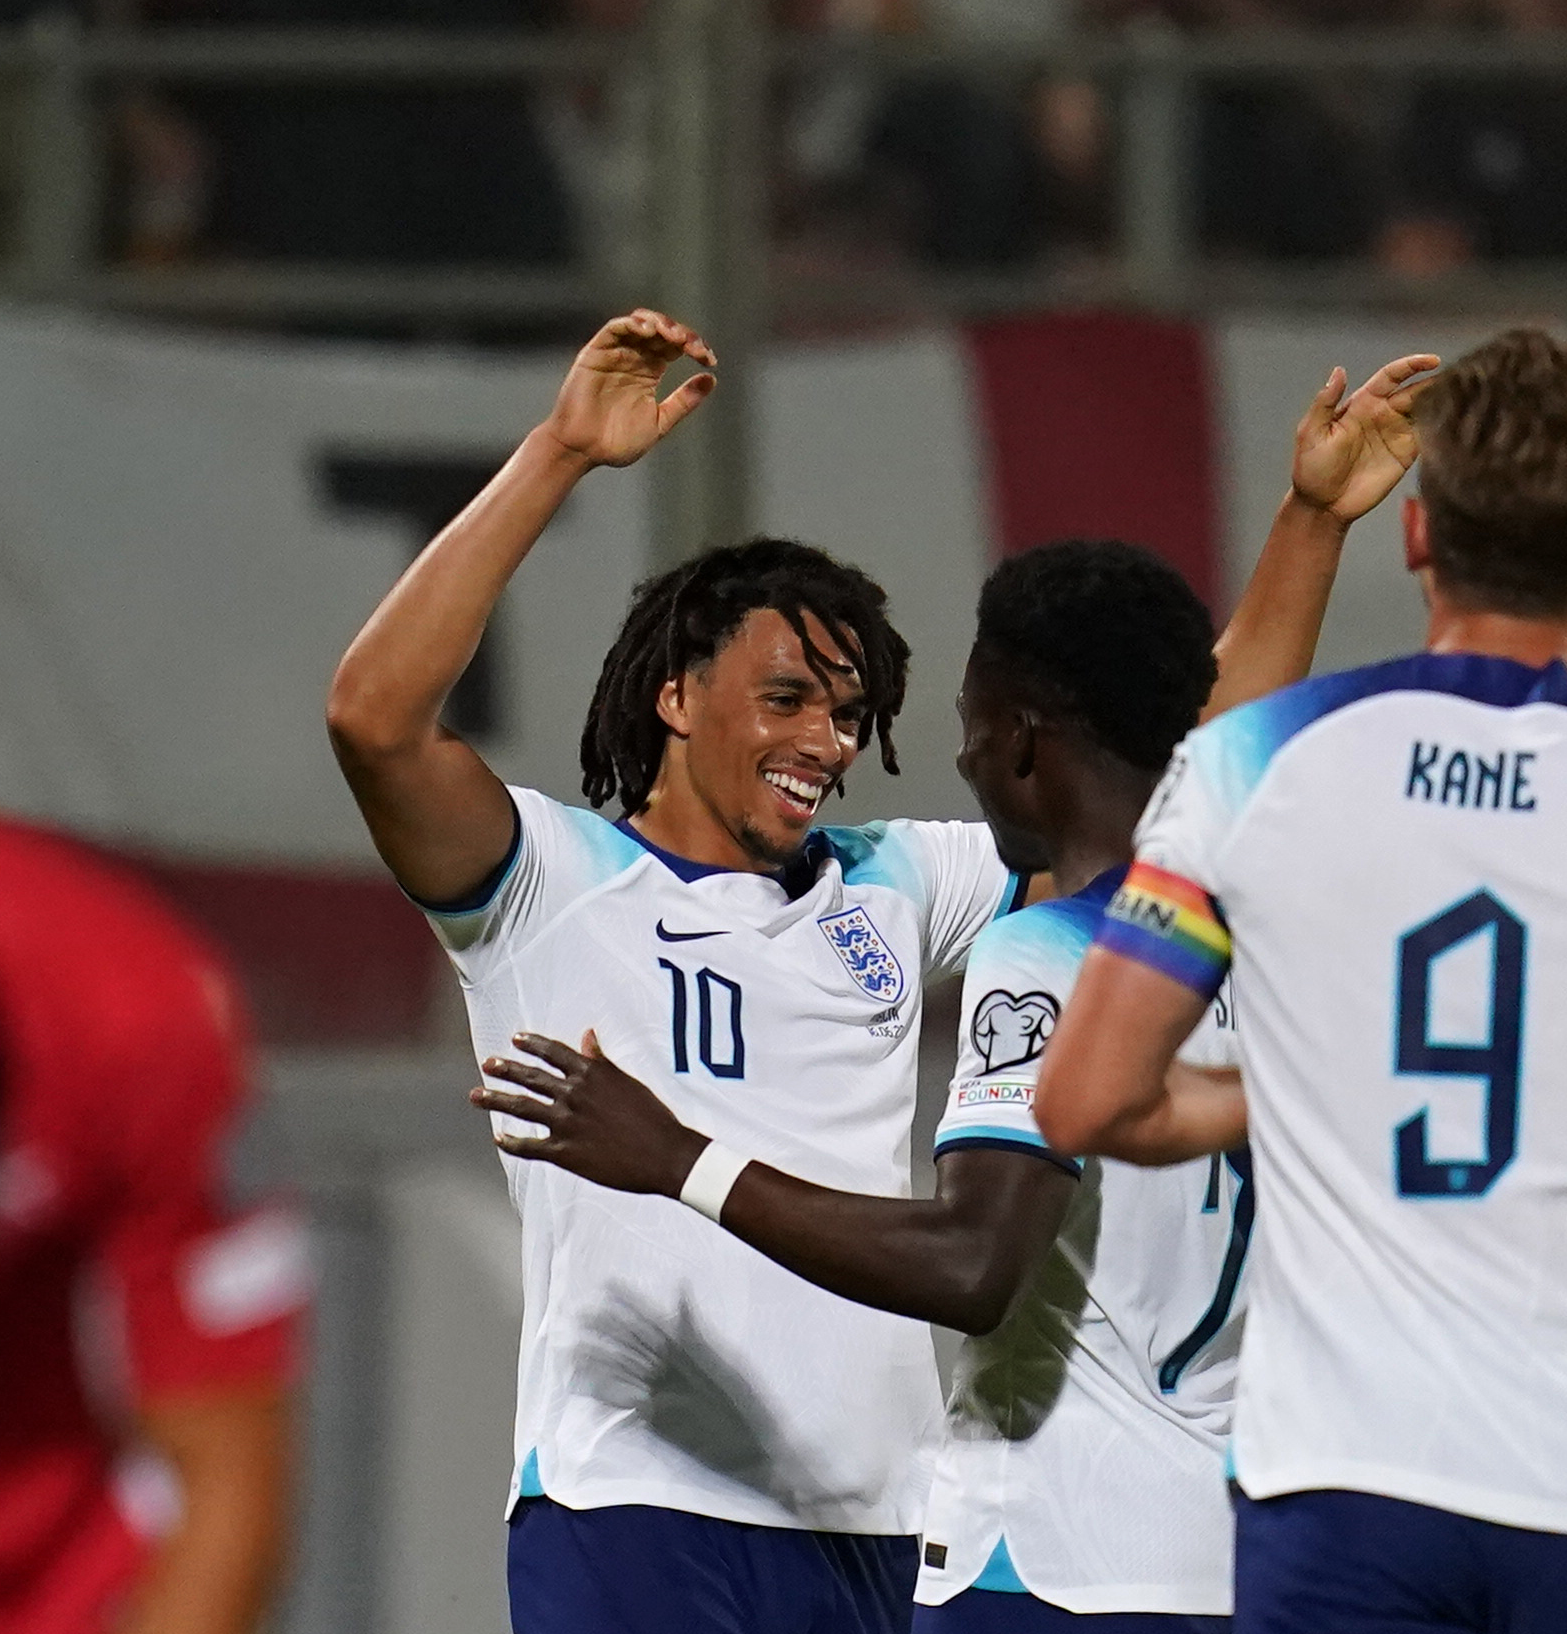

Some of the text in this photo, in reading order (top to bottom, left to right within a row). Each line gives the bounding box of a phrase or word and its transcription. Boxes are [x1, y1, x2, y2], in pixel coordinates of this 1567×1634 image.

[1405, 739, 1537, 813] KANE
[657, 956, 745, 1080] 10
[1394, 884, 1527, 1200] 9
